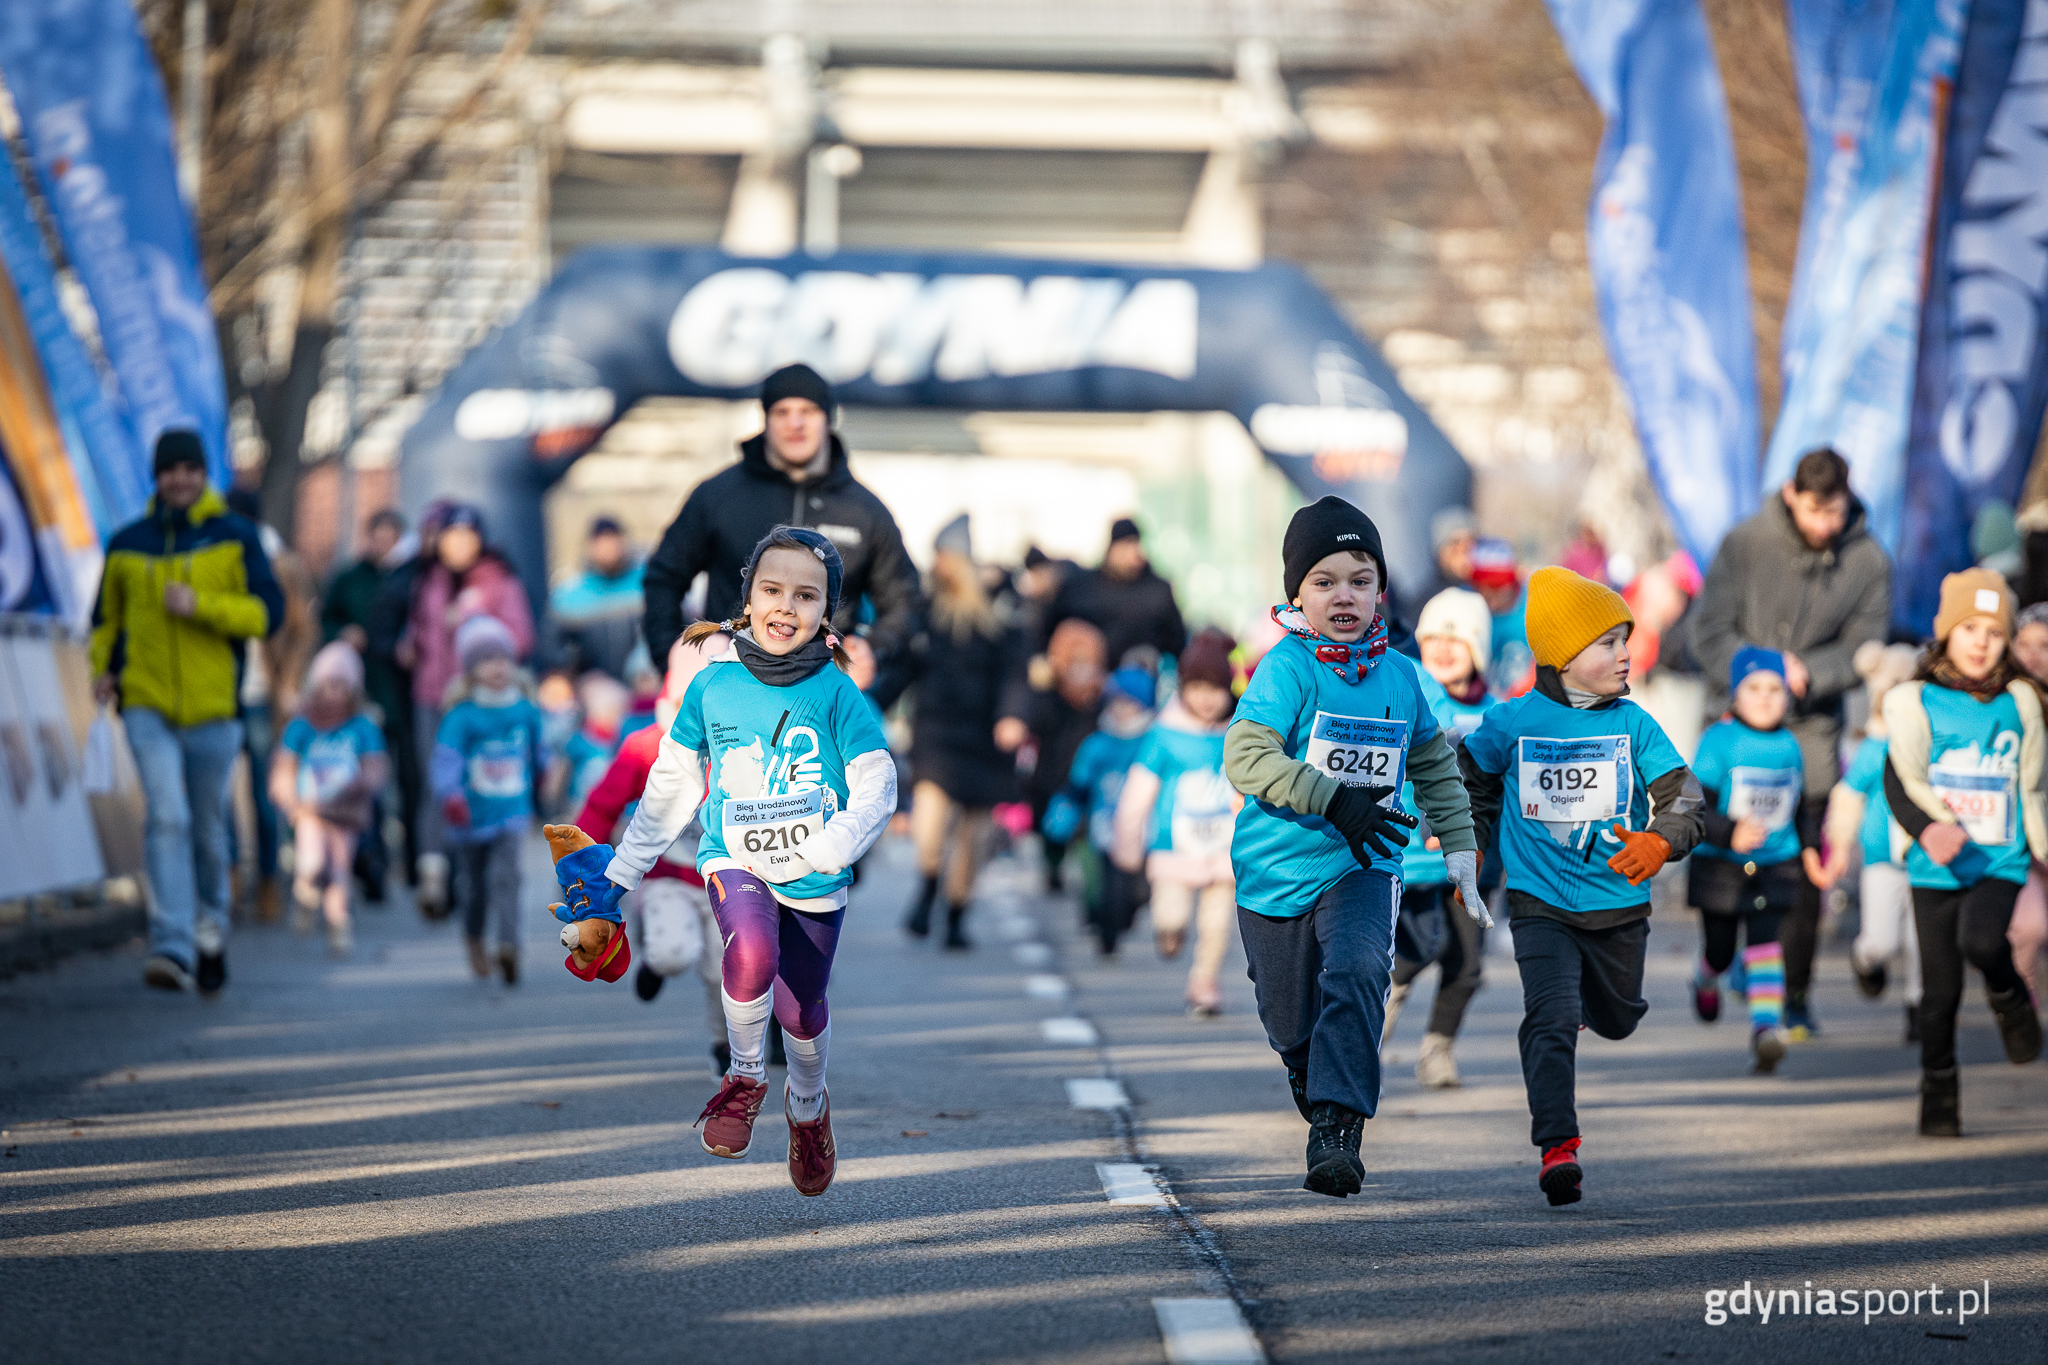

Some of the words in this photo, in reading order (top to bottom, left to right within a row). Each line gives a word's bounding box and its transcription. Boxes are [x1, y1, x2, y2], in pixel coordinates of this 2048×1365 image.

[667, 267, 1197, 387] GDYNIA
[1336, 533, 1361, 542] KIPSTA
[1331, 720, 1350, 731] Bieg
[1353, 723, 1396, 735] Urodzinowy
[1326, 729, 1351, 740] Gdyni
[1366, 735, 1396, 744] DECATHLON
[1535, 742, 1552, 751] Bieg
[1554, 742, 1601, 751] Urodzinowy
[1326, 748, 1389, 777] 6242
[1532, 751, 1553, 761] Gdyni
[1571, 752, 1605, 760] DECATHLON
[1539, 767, 1598, 791] 6192
[736, 803, 754, 813] Bieg
[757, 797, 808, 810] Urodzinowy
[1550, 795, 1585, 805] Olgierd
[734, 812, 758, 823] Gdyni
[778, 805, 813, 818] DECATHLON
[1526, 803, 1539, 817] M
[743, 823, 809, 853] 6210
[770, 855, 790, 865] Ewa
[731, 1056, 765, 1070] IPST
[790, 1090, 823, 1105] KIPST
